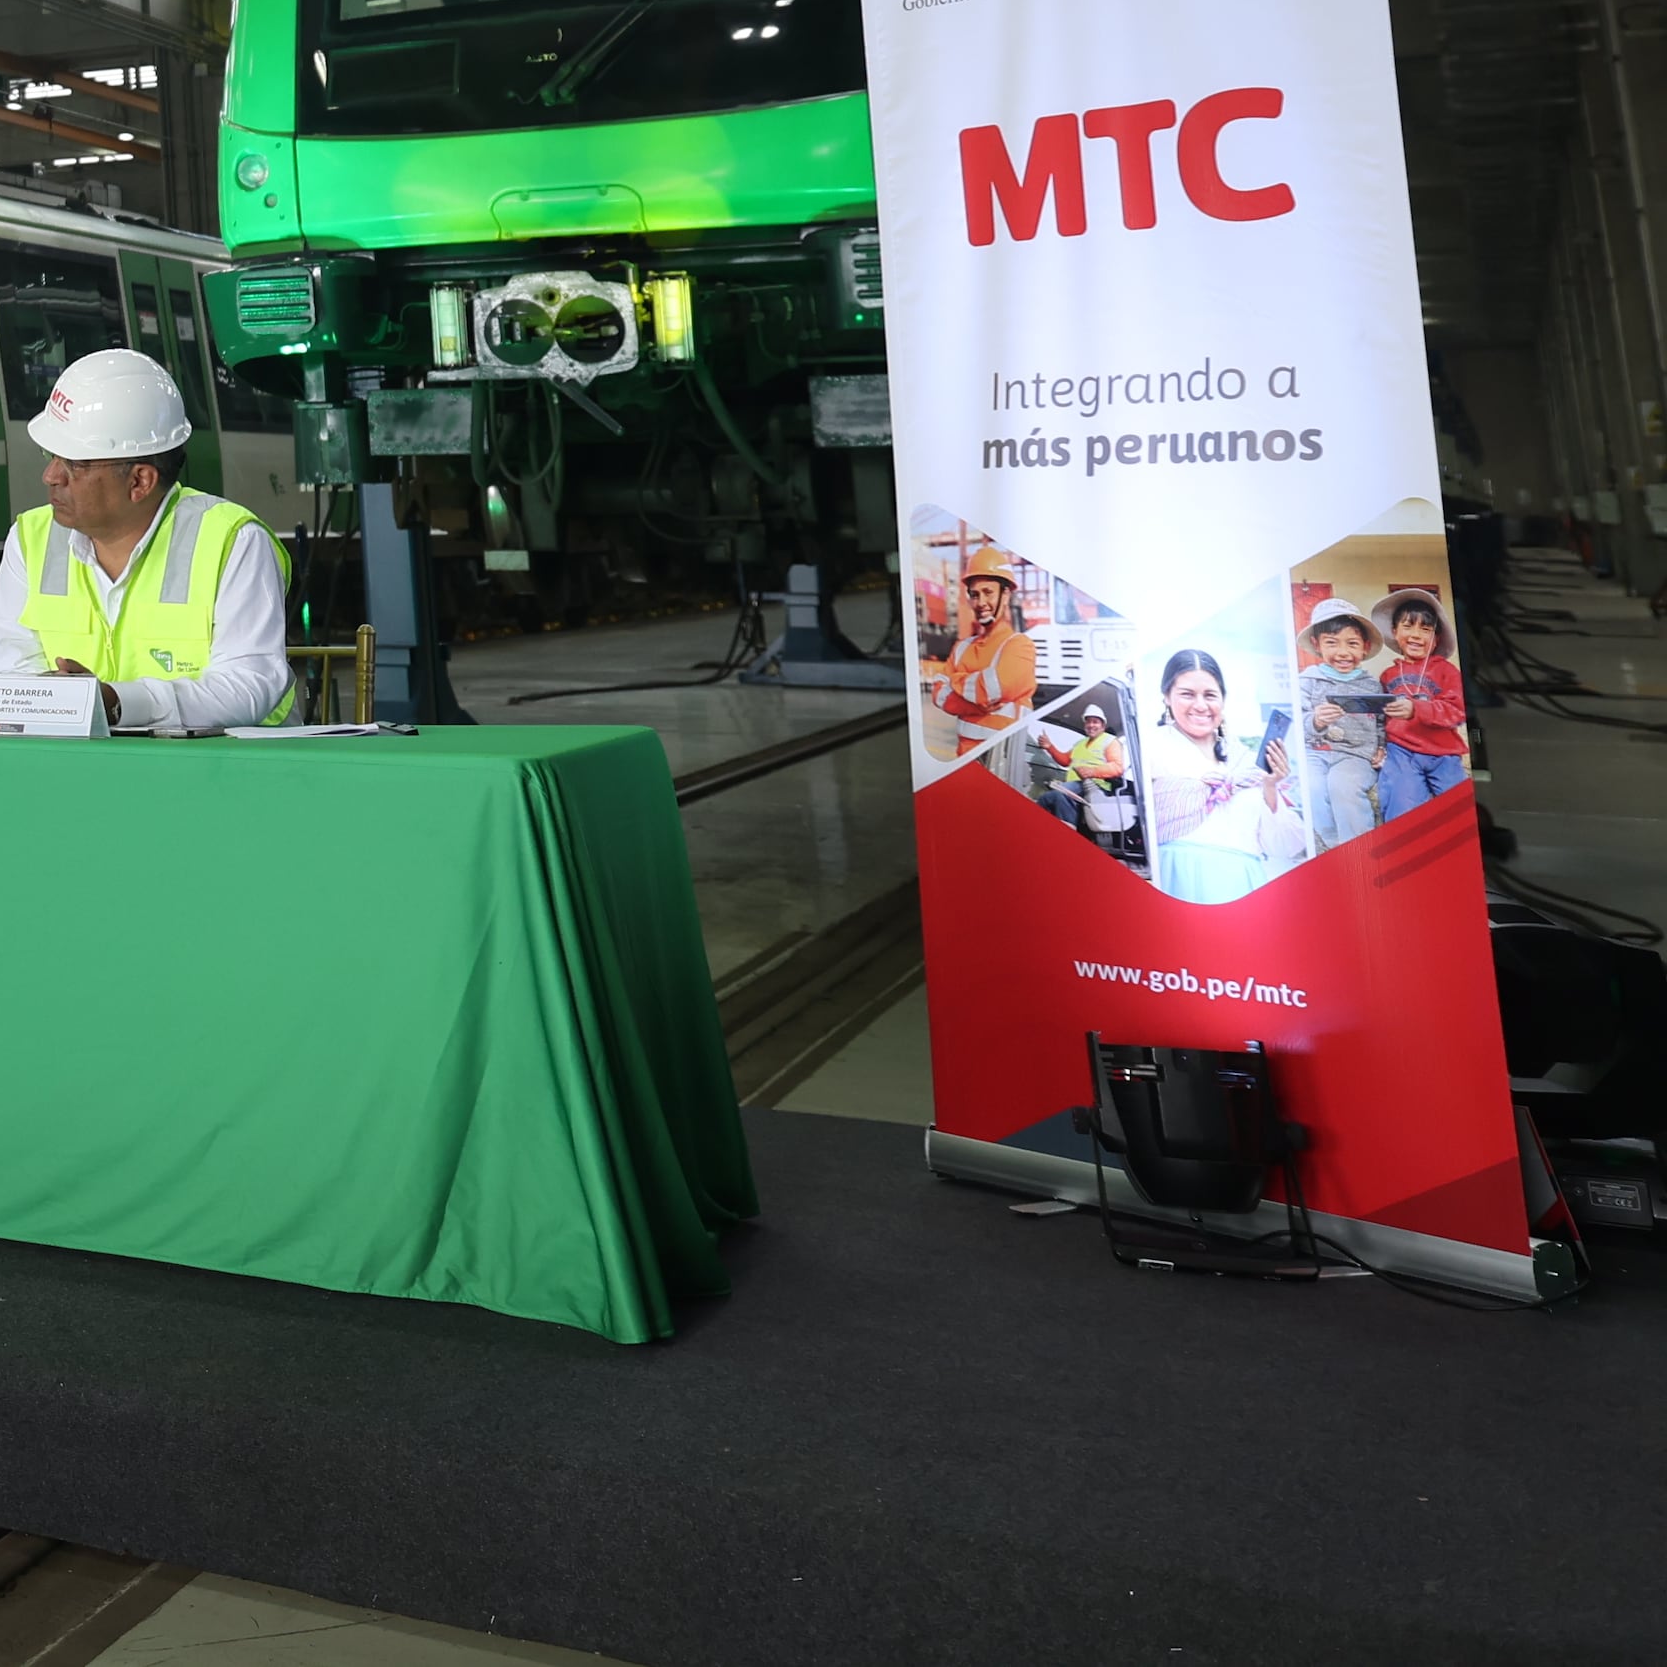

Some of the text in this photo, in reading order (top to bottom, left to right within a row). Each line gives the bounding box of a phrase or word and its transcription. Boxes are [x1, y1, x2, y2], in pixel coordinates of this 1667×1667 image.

[958, 86, 1297, 248] MTC
[51, 387, 74, 414] MTC
[993, 356, 1301, 418] Integrando a
[982, 427, 1325, 477] más peruanos
[14, 688, 53, 697] BARRERA
[21, 707, 78, 715] COMUNICACIONES
[1073, 959, 1309, 1009] www.gob.pe/mtc
